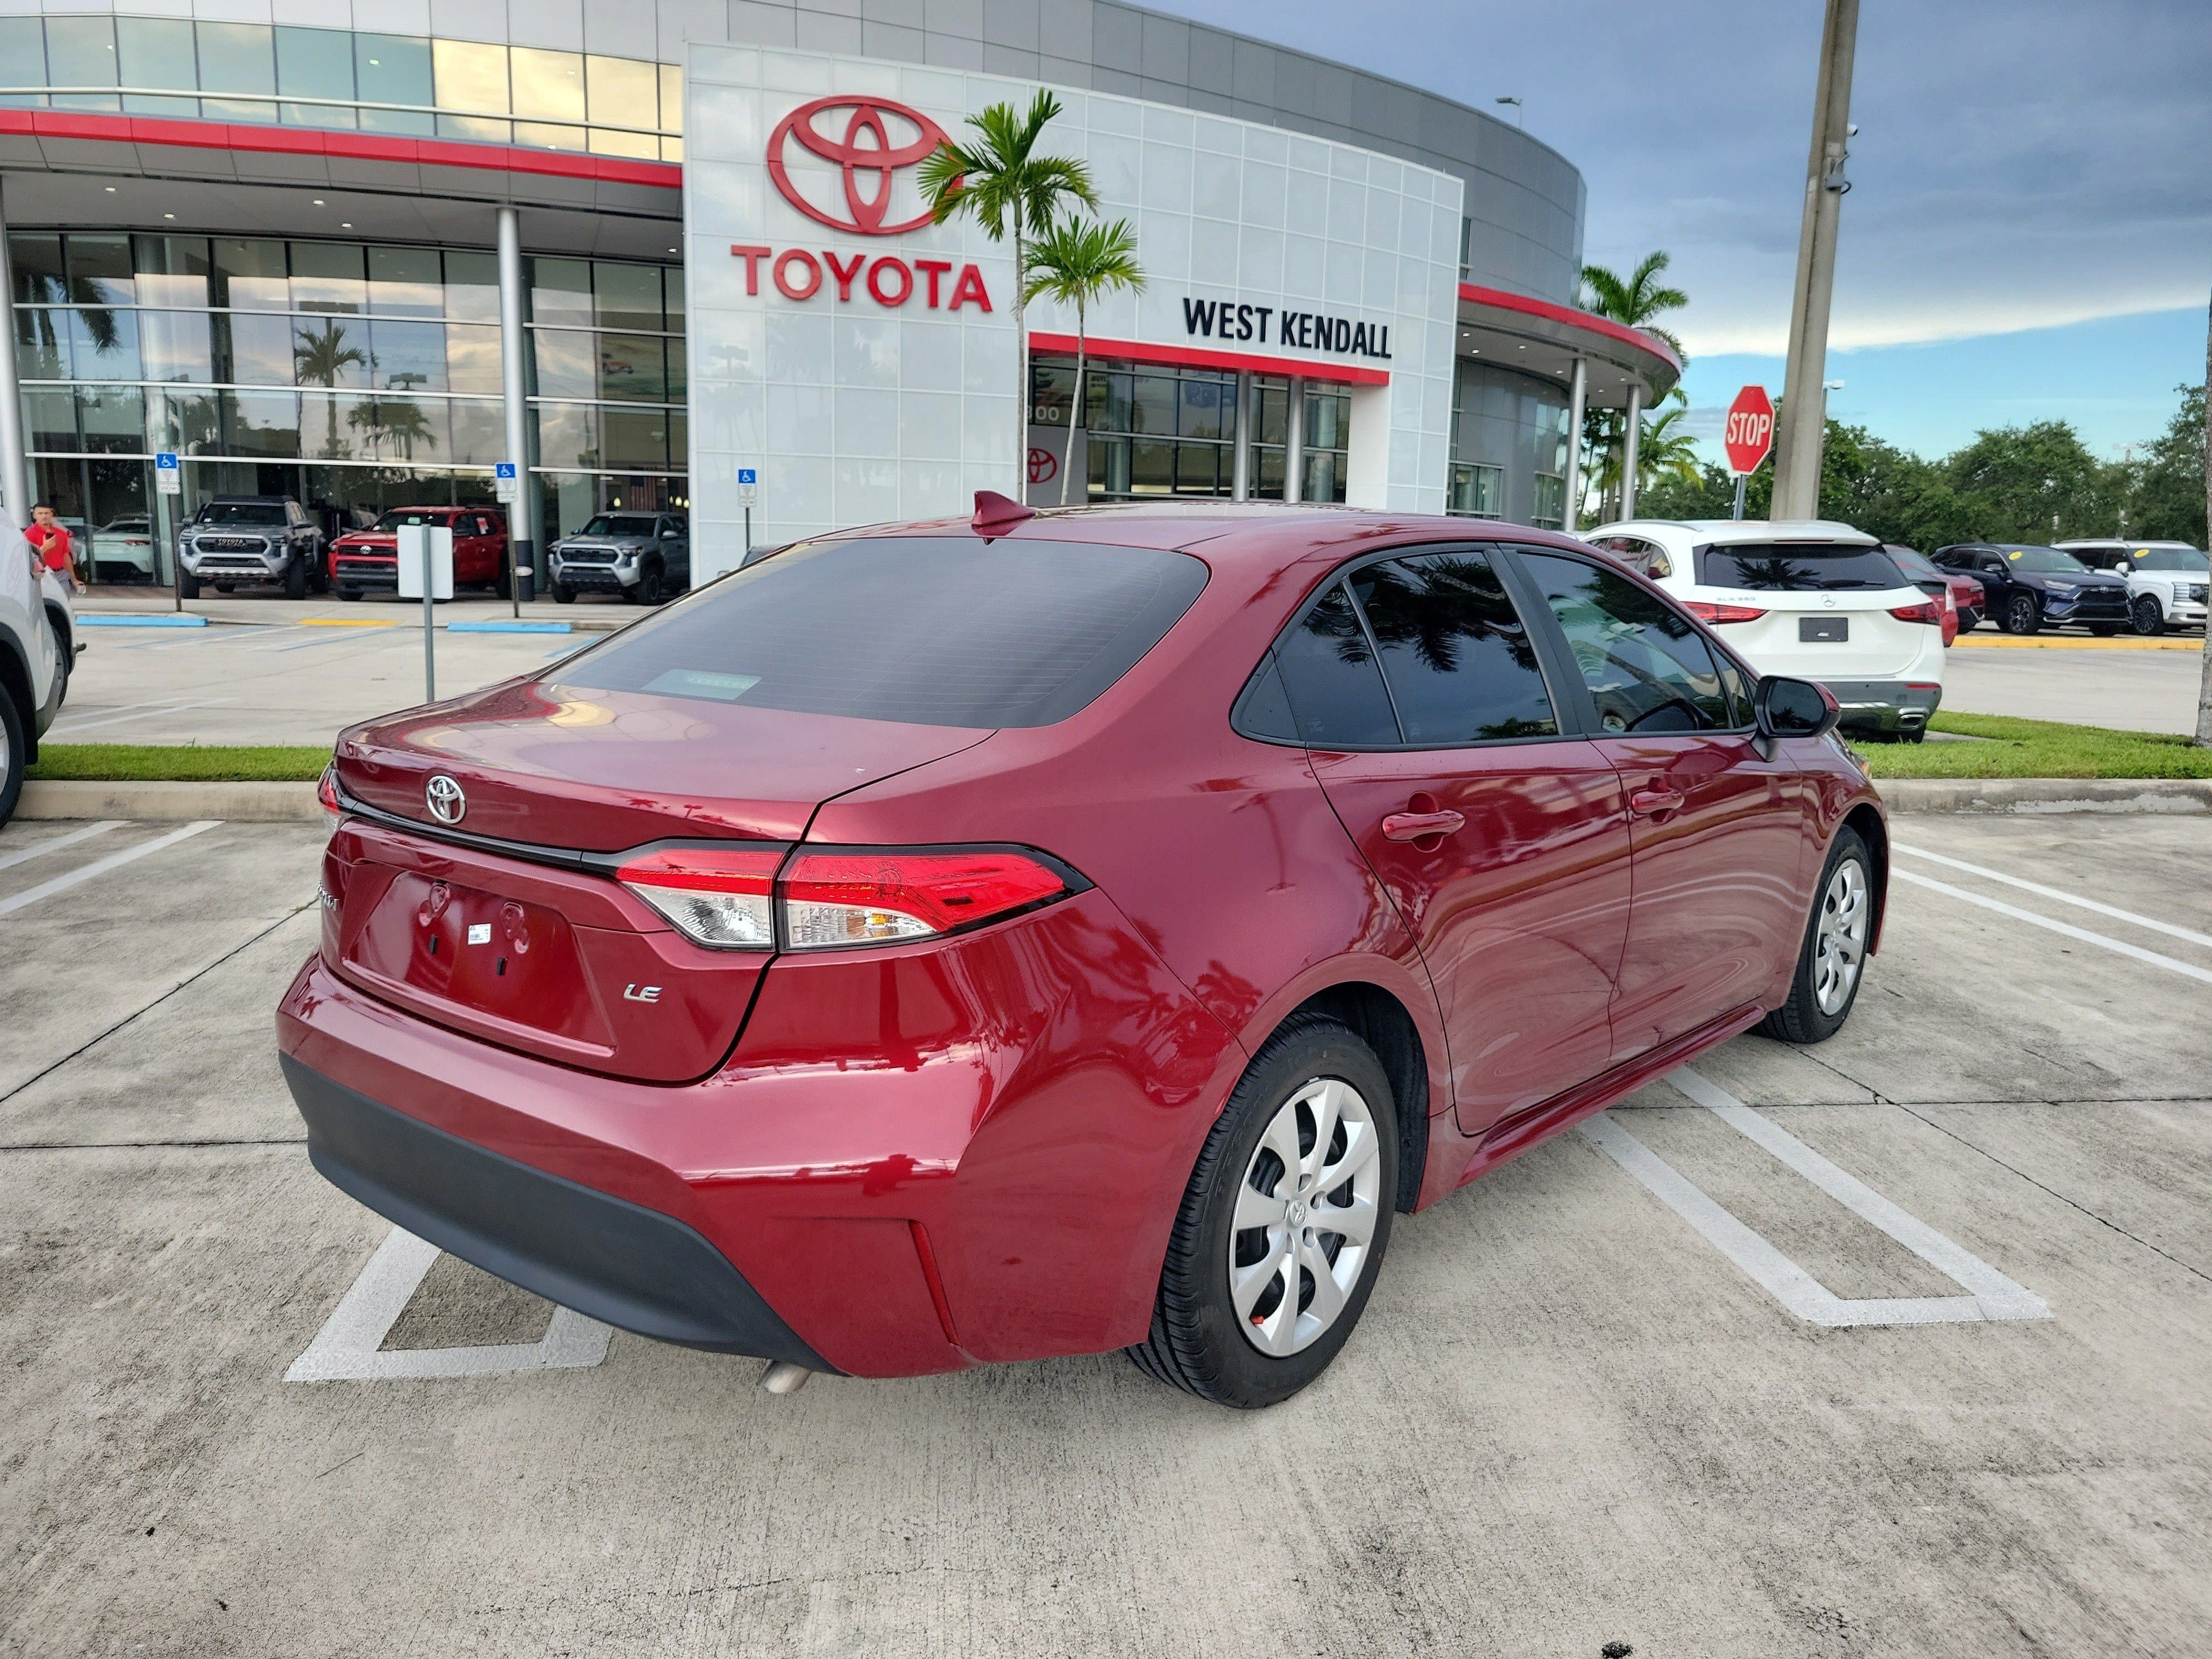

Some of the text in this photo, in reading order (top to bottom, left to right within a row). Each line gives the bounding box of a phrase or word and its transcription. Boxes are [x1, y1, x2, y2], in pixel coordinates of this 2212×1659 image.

[731, 244, 992, 312] TOYOTA
[1183, 298, 1392, 359] WEST KENDALL
[1727, 411, 1770, 446] STOP
[218, 538, 246, 546] TOYOTA
[624, 984, 663, 1003] LE
